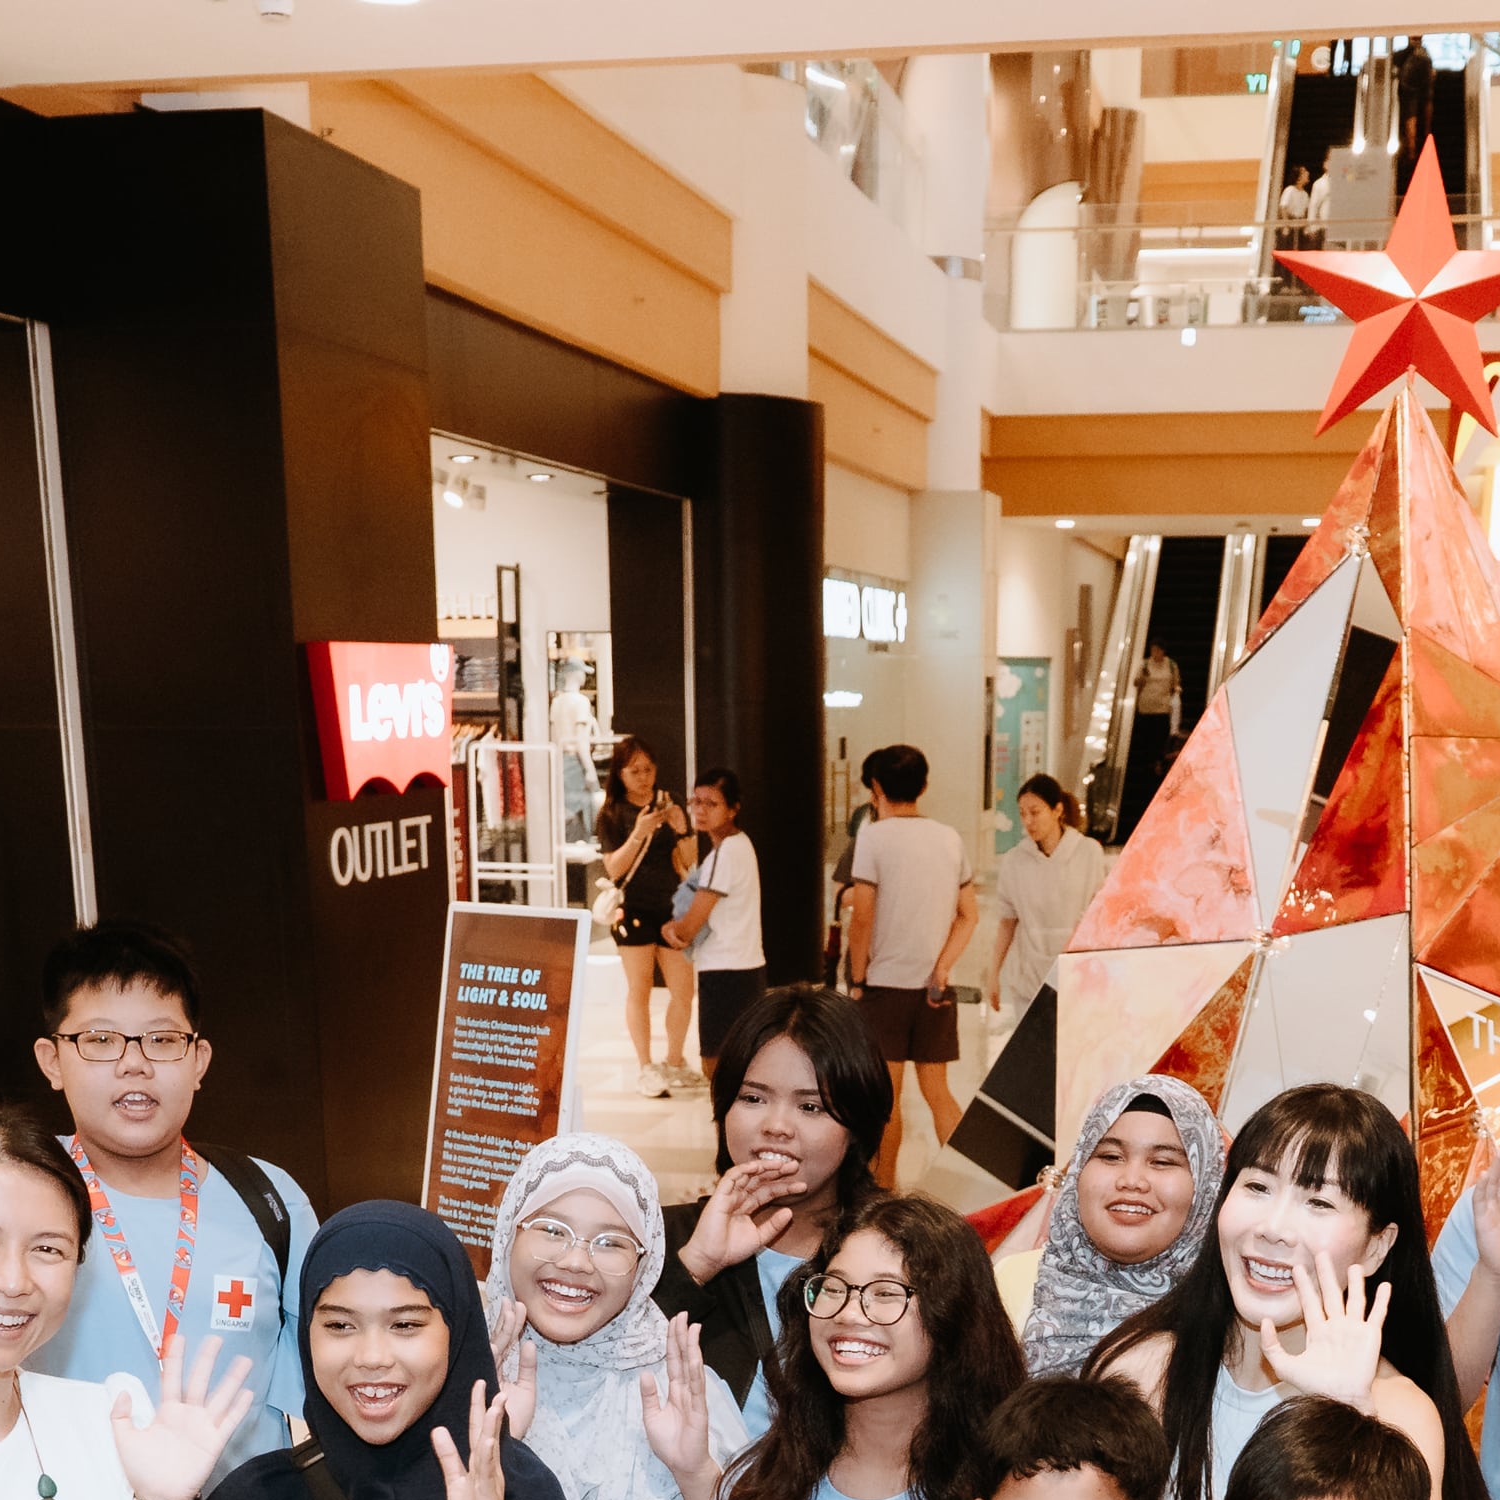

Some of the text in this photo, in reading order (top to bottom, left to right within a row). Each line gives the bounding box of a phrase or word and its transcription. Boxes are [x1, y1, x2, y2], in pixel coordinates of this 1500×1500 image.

[330, 814, 432, 887] OUTLET
[460, 962, 541, 986] THE TREE OF
[457, 985, 548, 1011] LIGHT & SOUL
